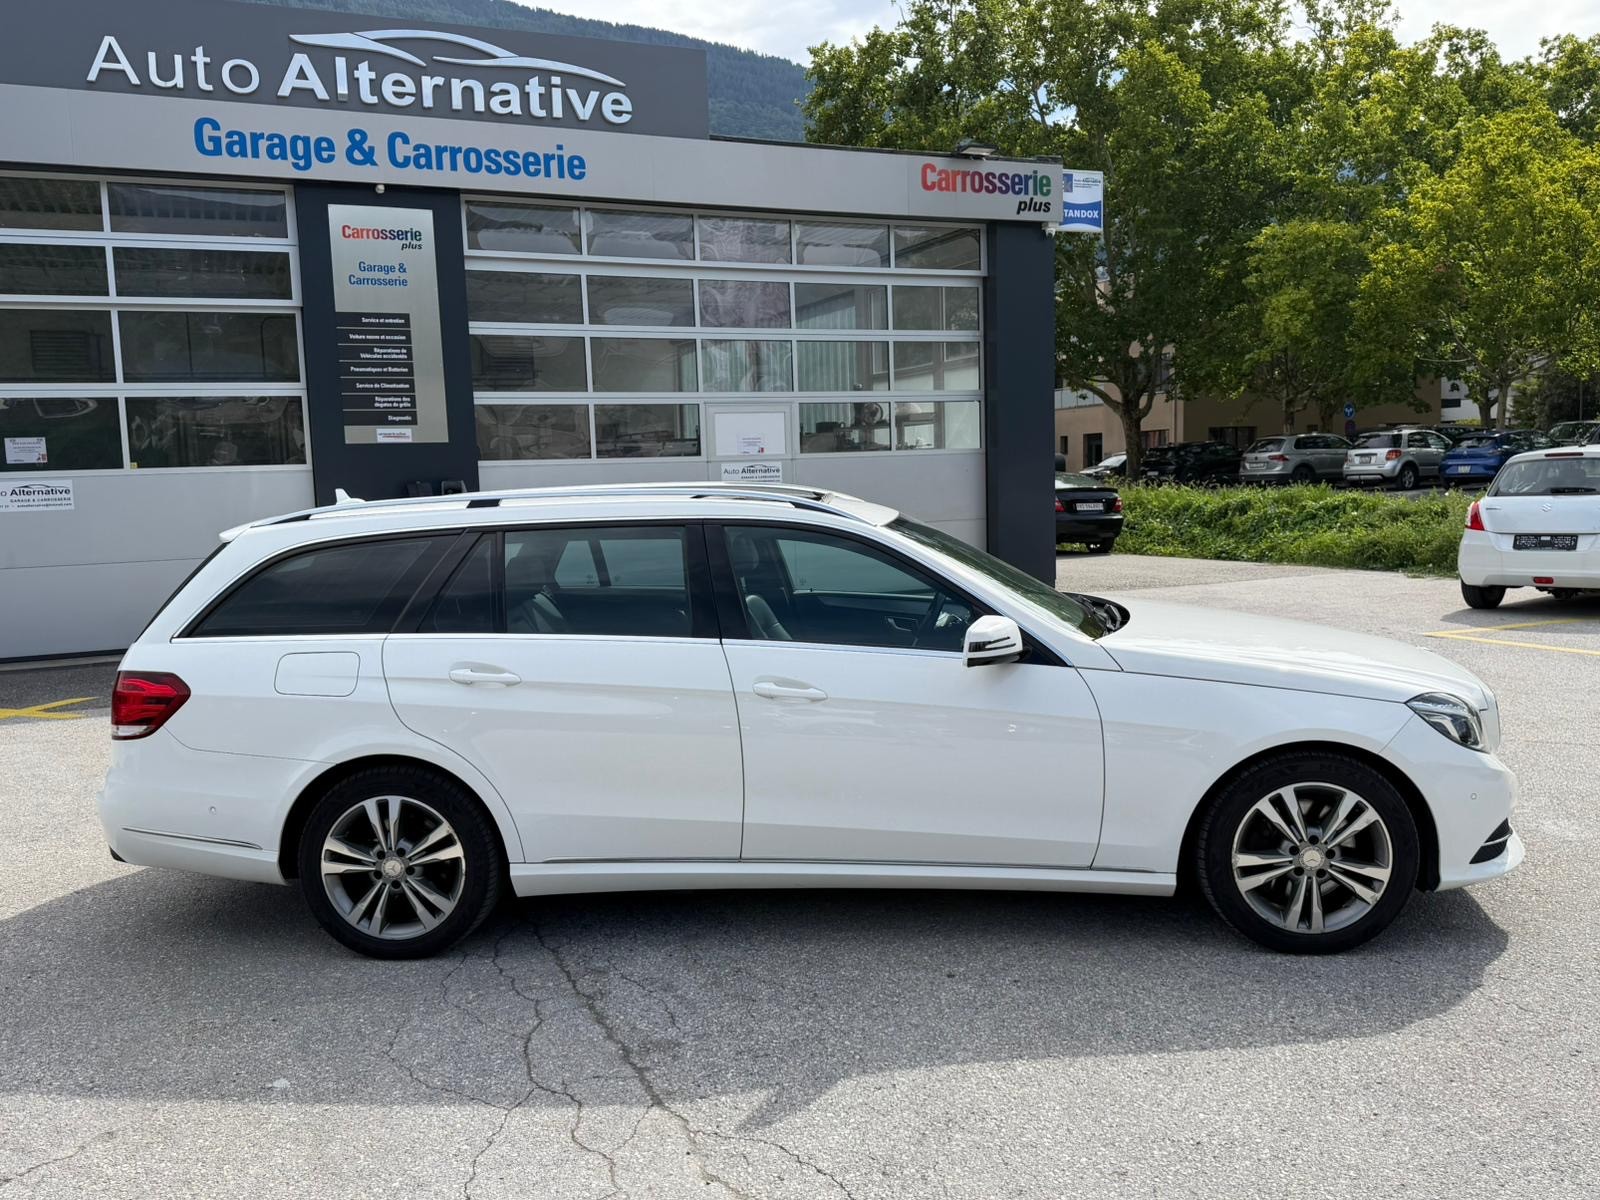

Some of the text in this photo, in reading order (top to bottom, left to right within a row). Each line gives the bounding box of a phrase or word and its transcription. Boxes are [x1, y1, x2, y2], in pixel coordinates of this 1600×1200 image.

[86, 34, 633, 126] Auto Alternative
[193, 116, 587, 182] Garage & Carrosserie
[920, 162, 1052, 197] Carrosserie
[1016, 197, 1051, 215] plus
[341, 224, 422, 242] Carrosserie
[401, 241, 423, 251] plus
[358, 261, 407, 275] Garage &
[348, 274, 408, 287] Carrosserie
[10, 487, 71, 497] Alternative
